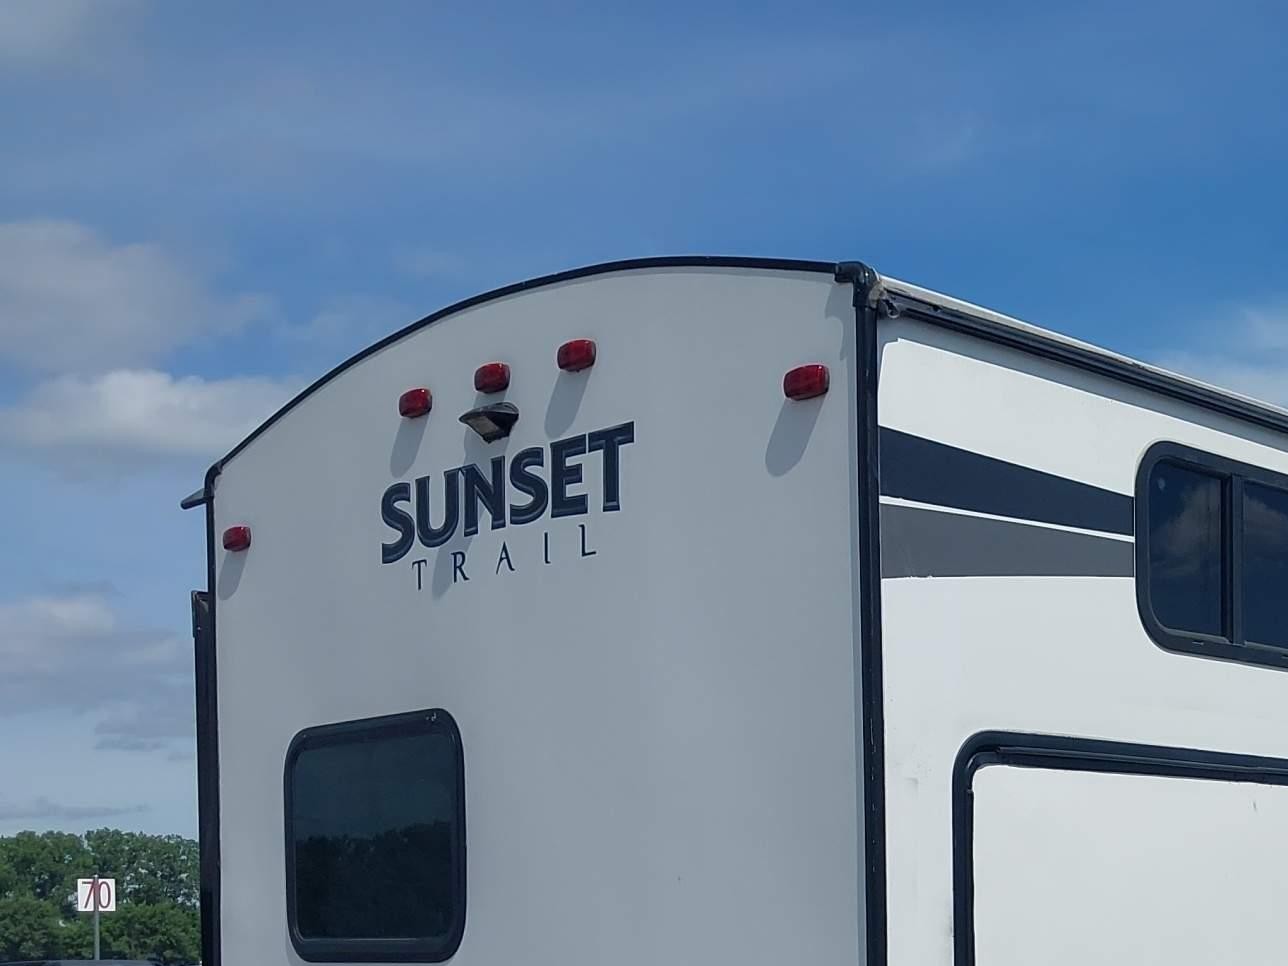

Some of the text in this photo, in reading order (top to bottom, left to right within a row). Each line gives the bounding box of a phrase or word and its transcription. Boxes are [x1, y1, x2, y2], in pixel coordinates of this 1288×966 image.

[381, 421, 635, 565] SUNSET
[411, 523, 597, 591] TRAIL
[81, 880, 112, 909] 70
